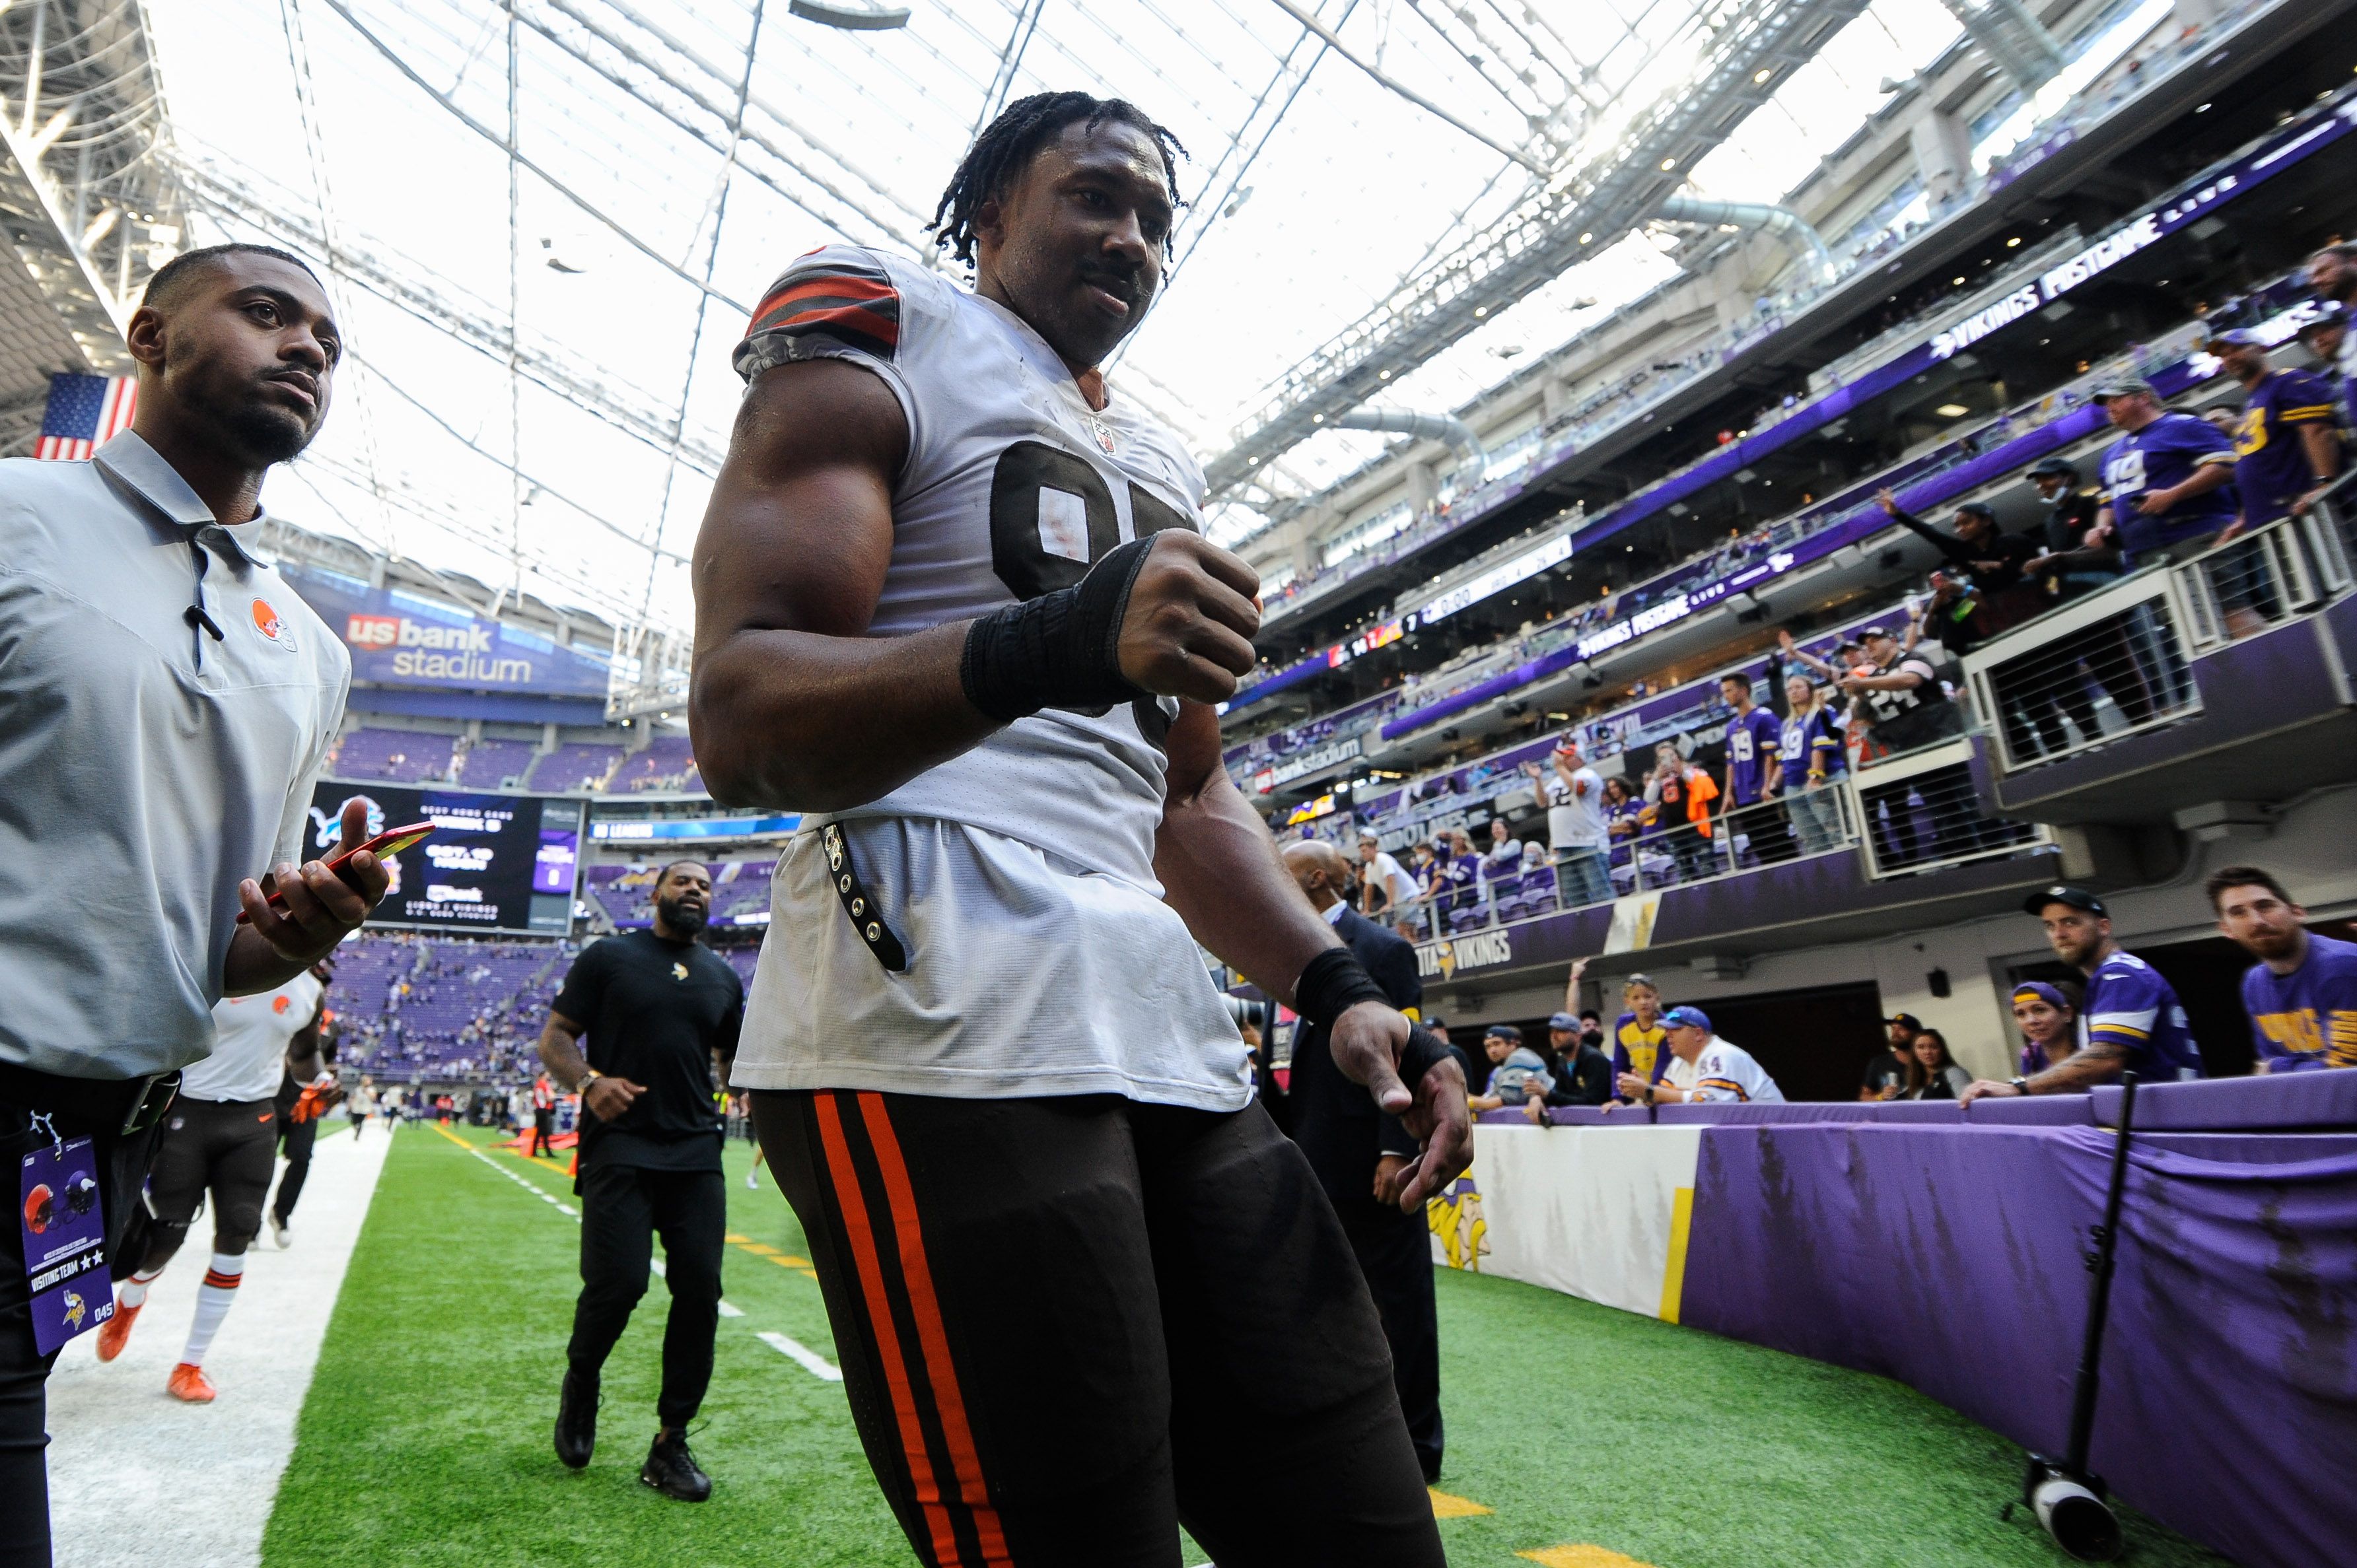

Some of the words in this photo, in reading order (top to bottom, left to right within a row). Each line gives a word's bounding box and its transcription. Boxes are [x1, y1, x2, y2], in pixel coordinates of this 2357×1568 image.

[1951, 284, 2040, 347] VIKINGS
[2040, 213, 2164, 299] POSTGAME
[392, 648, 532, 683] stadium
[1452, 930, 1512, 970] VIKINGS
[31, 1268, 61, 1293] VISITING
[59, 1259, 79, 1279] TEAM
[94, 1302, 113, 1322] 045
